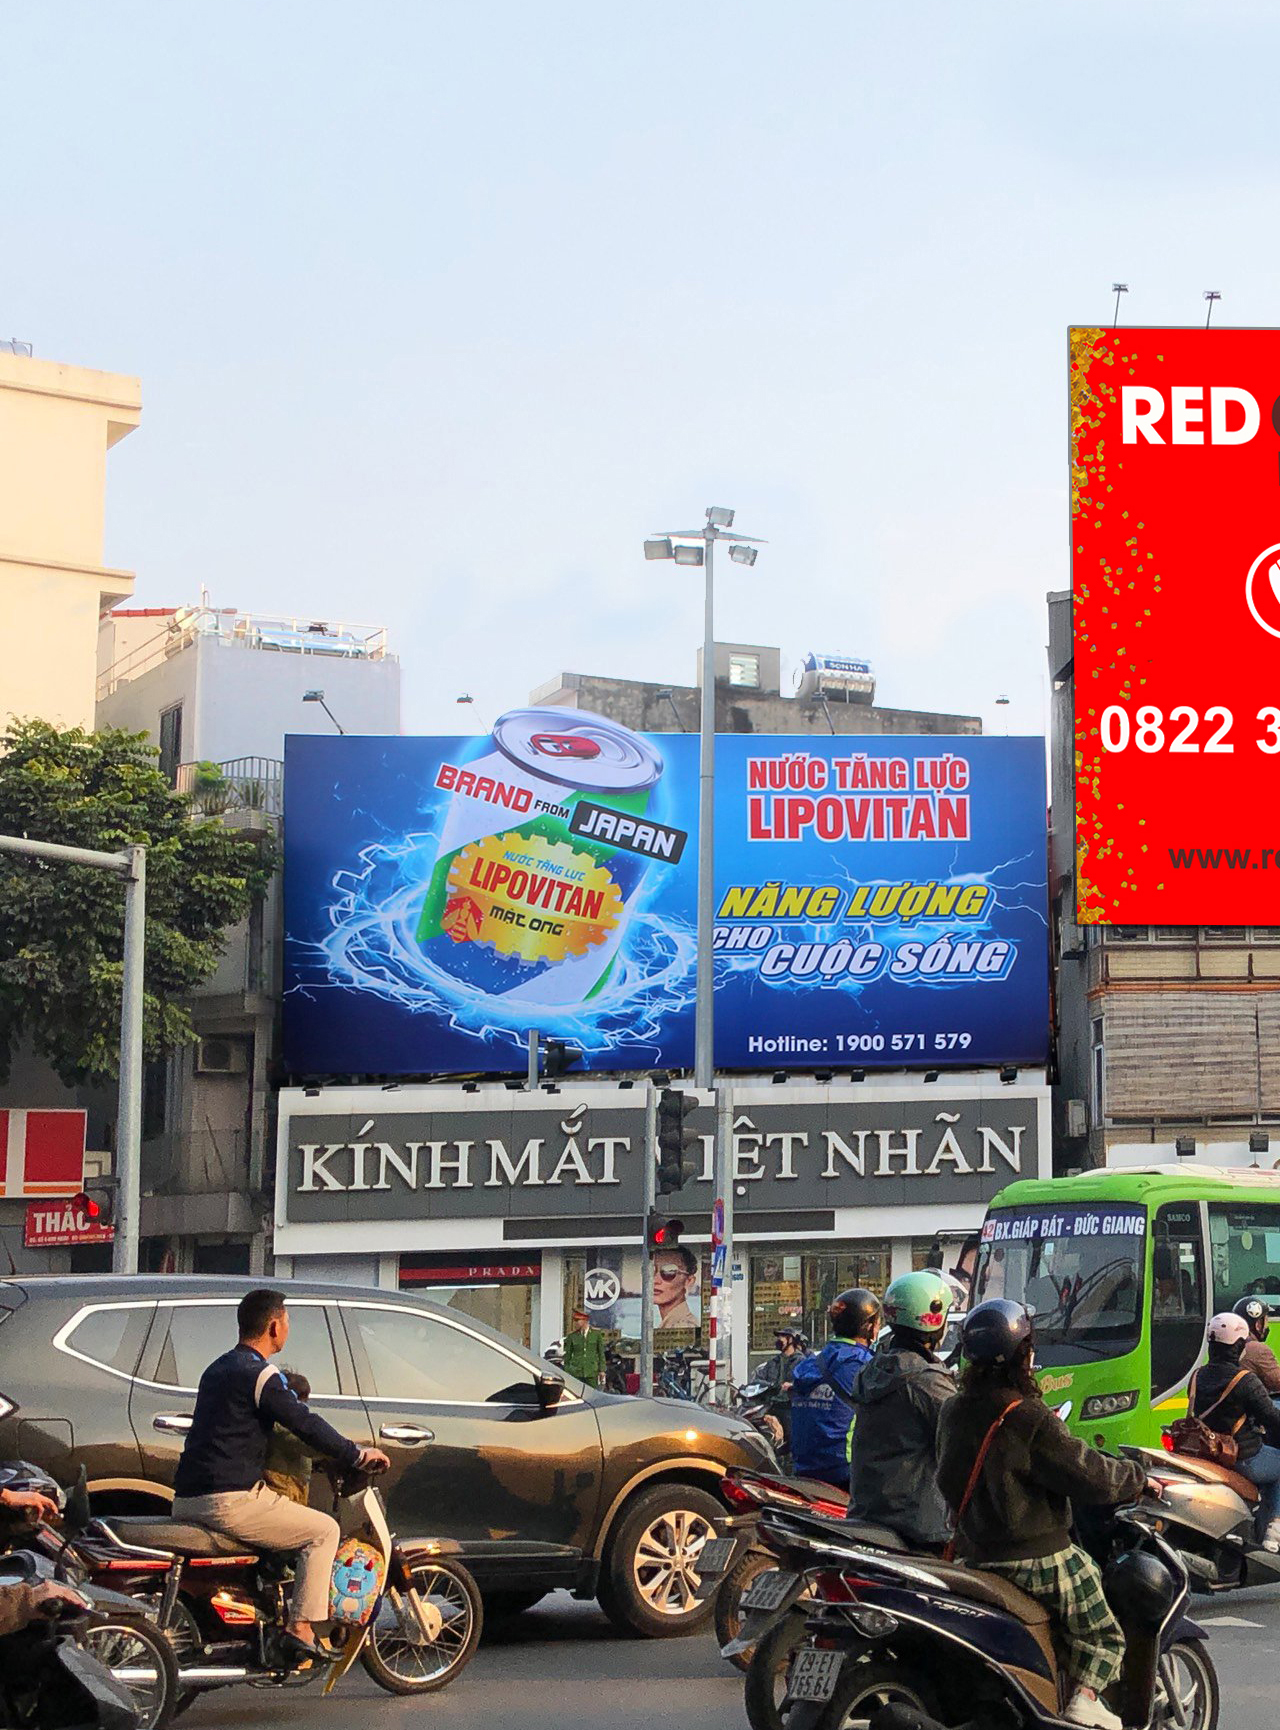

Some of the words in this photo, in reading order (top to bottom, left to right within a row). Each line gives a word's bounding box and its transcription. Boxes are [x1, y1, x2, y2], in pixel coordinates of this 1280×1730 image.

[1121, 385, 1261, 445] RED
[1101, 705, 1235, 754] 0822
[747, 753, 829, 791] NƯỚC
[832, 753, 909, 791] TĂNG
[915, 753, 970, 794] LỰC
[435, 763, 534, 814] BRAND
[534, 799, 571, 819] FROM
[578, 809, 677, 858] JAPAN
[747, 795, 971, 841] LIPOVITAN
[502, 850, 535, 868] NƯỚC
[535, 857, 563, 876] TĂNG
[469, 857, 605, 920] LIPOVITAN
[718, 881, 840, 919] NĂNG
[846, 881, 990, 923] LƯỢNG
[712, 926, 774, 951] CHO
[758, 939, 885, 981] CUỘC
[890, 932, 1011, 977] SỐNG
[748, 1036, 829, 1053] Hotline:
[835, 1034, 885, 1052] 1900
[890, 1033, 926, 1051] 571
[934, 1032, 972, 1050] 579
[297, 1119, 476, 1192] KÍNH
[484, 1102, 631, 1186] MẮT
[655, 1115, 809, 1196] IỆT
[821, 1111, 1026, 1178] NHÃN
[995, 1216, 1039, 1240] BX.GIÁP
[1040, 1214, 1065, 1238] BÁT
[1073, 1213, 1099, 1236] ĐỨC
[1102, 1215, 1145, 1236] GIANG
[469, 1265, 535, 1277] PRADA
[585, 1278, 616, 1299] MK
